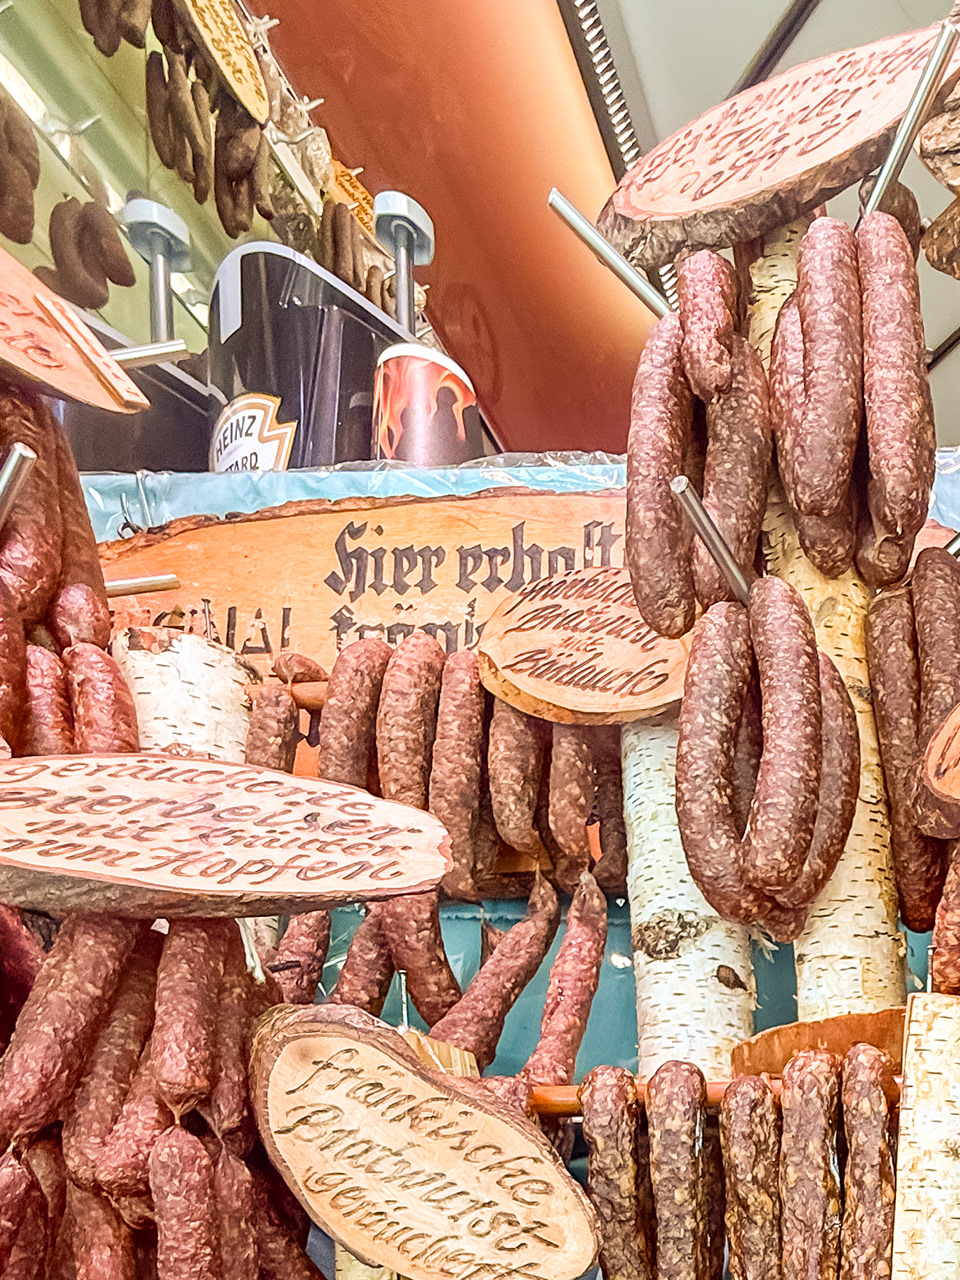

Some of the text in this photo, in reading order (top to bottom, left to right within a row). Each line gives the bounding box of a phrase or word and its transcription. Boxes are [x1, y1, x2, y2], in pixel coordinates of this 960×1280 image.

[216, 415, 257, 463] HEINZ
[324, 521, 446, 603] Hier
[502, 648, 669, 696] Bärlauch
[131, 848, 405, 886] Hopfen
[274, 1103, 560, 1252] Bratwurst
